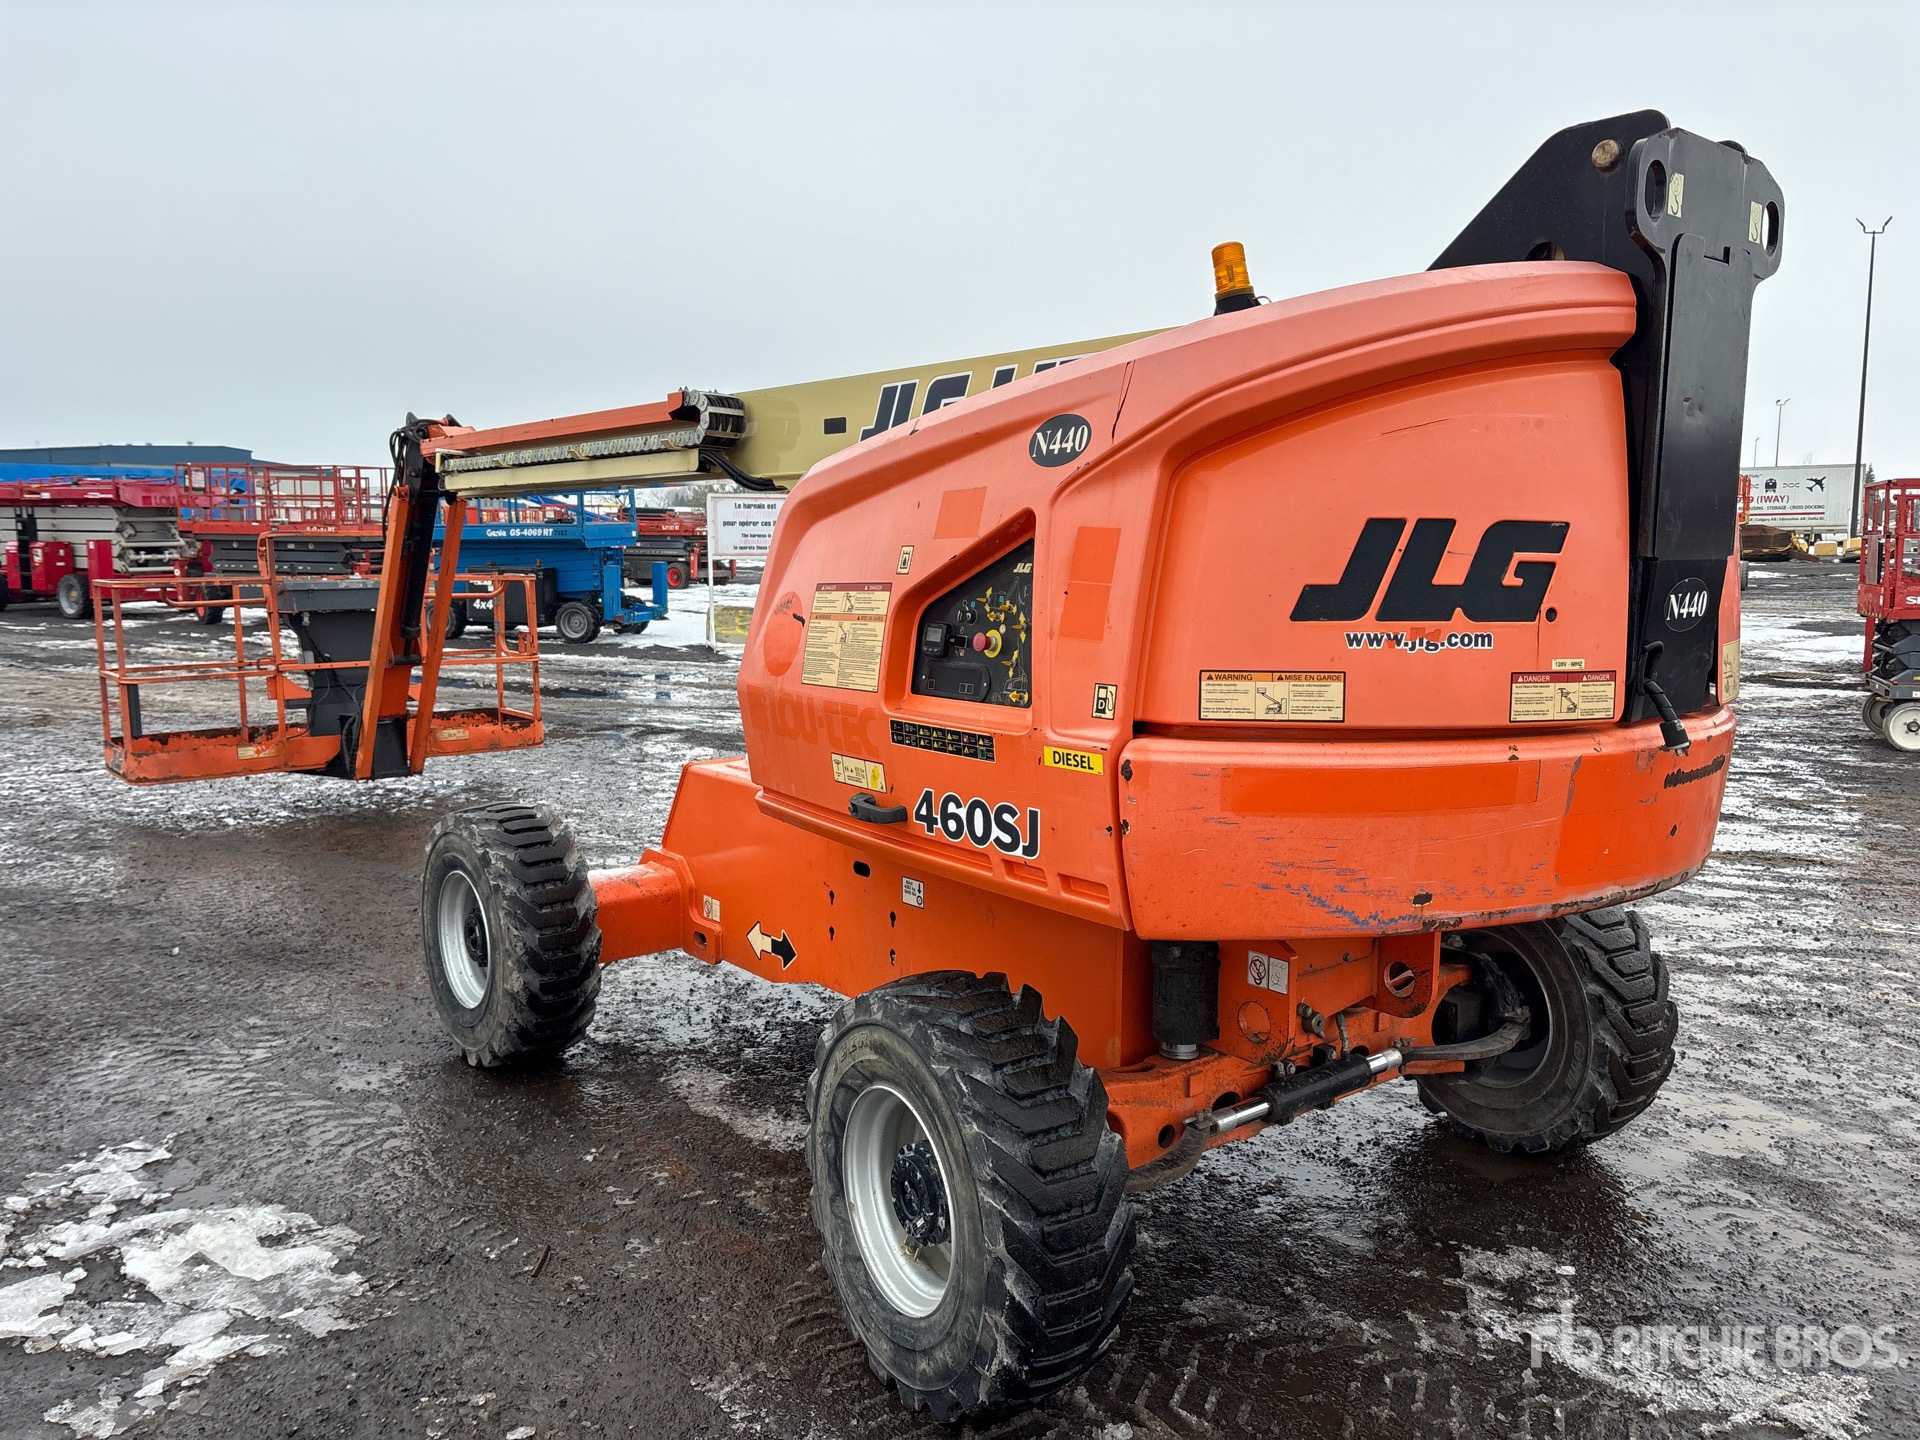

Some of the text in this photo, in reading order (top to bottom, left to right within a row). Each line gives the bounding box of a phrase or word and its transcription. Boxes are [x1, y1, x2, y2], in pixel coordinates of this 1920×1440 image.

[1031, 424, 1089, 458] N440
[1756, 495, 1790, 505] (IWAY)
[486, 528, 554, 537] Genie GS-4069 RT
[1013, 562, 1033, 573] JLG
[1290, 518, 1571, 622] JLG
[473, 598, 494, 610] 4x4
[1665, 590, 1708, 621] N440
[1215, 673, 1253, 681] WARNING
[1316, 674, 1342, 682] GARDE
[1052, 750, 1095, 771] DIESEL
[913, 787, 1041, 860] 460SJ
